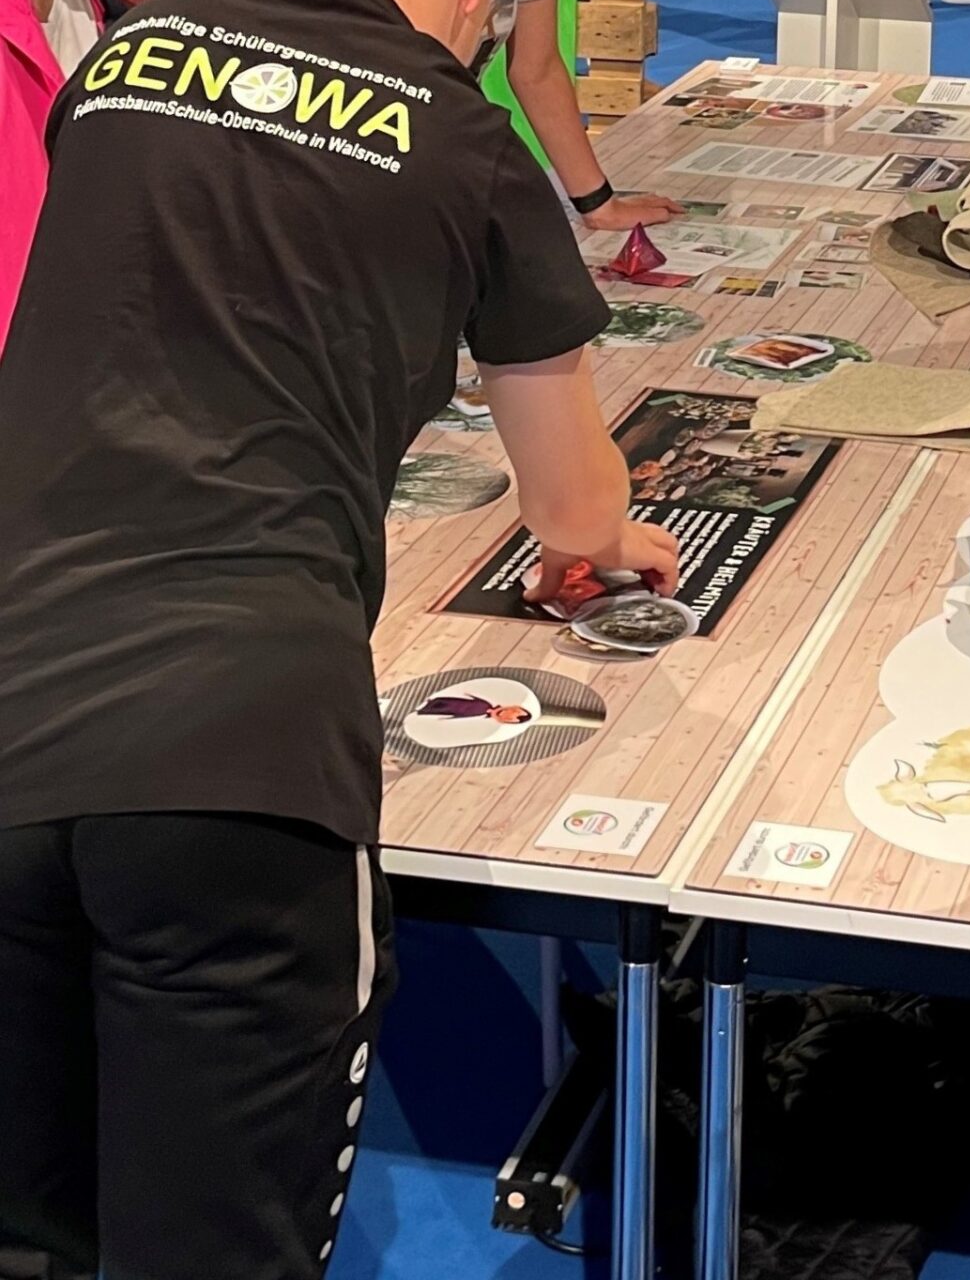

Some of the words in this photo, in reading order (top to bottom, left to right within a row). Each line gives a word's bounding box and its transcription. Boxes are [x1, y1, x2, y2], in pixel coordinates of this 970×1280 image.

[84, 37, 411, 153] GENOWA
[210, 26, 433, 104] Schülergenossenschaft
[309, 133, 326, 150] in
[328, 136, 402, 173] Walsrode
[731, 516, 776, 558] KRÄUTER
